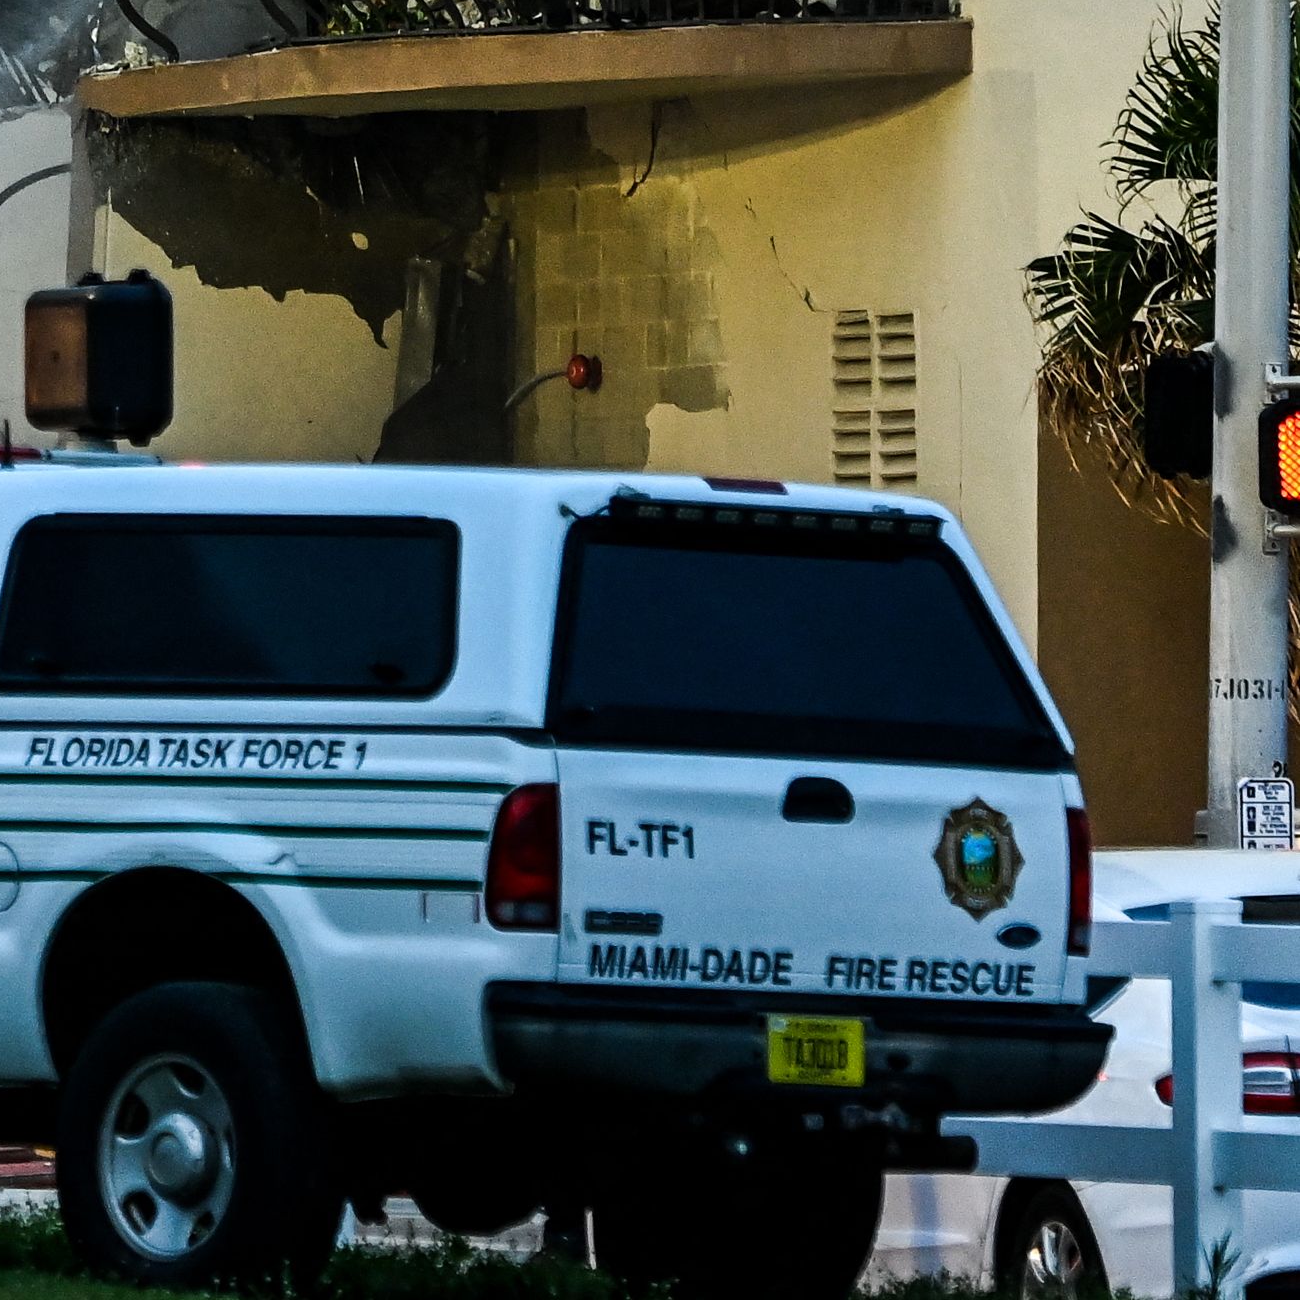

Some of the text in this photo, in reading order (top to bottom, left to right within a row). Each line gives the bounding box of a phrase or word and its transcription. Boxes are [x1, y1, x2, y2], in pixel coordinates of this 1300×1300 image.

[24, 736, 368, 770] FLORIDA TASK FORCE 1
[586, 819, 696, 860] FL-TF1
[588, 943, 1037, 997] MIAMI-DADE FIRE RESCUE
